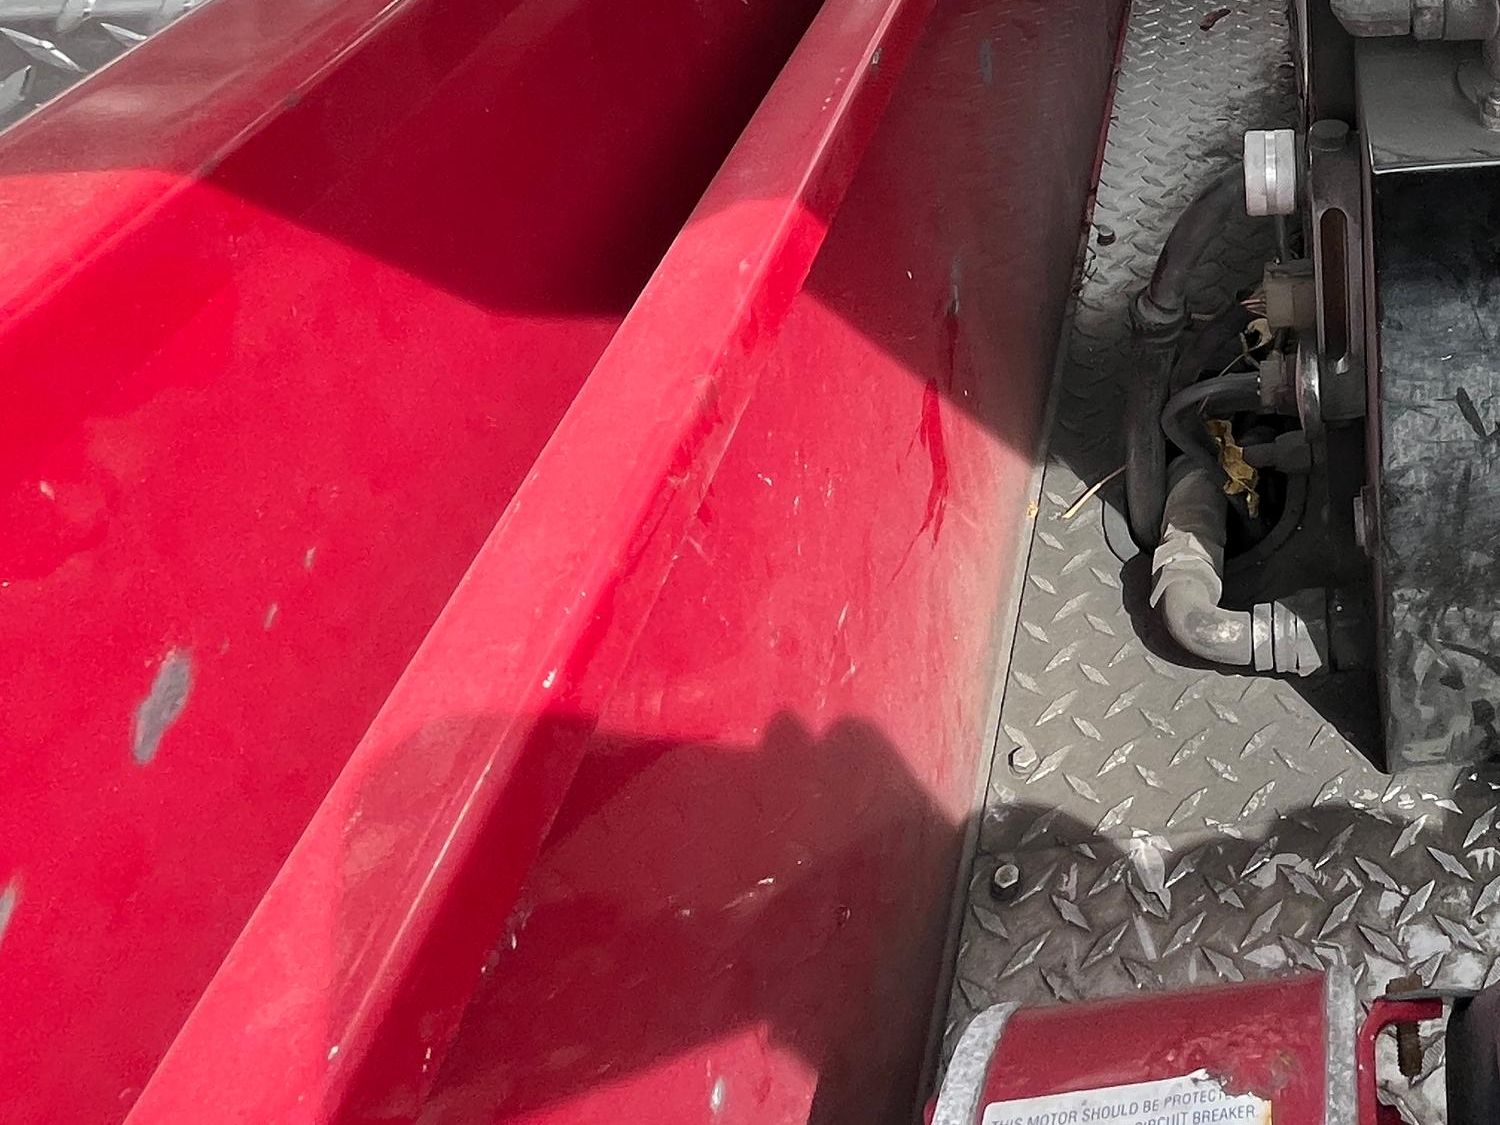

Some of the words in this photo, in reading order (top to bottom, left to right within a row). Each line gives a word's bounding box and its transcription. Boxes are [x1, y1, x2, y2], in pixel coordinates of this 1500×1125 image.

[1027, 1110, 1077, 1125] MOTOR
[1081, 1101, 1139, 1123] SHOULD
[1143, 1099, 1160, 1113] BE
[1164, 1088, 1231, 1107] PROTECT
[1193, 1104, 1256, 1125] BREAKER
